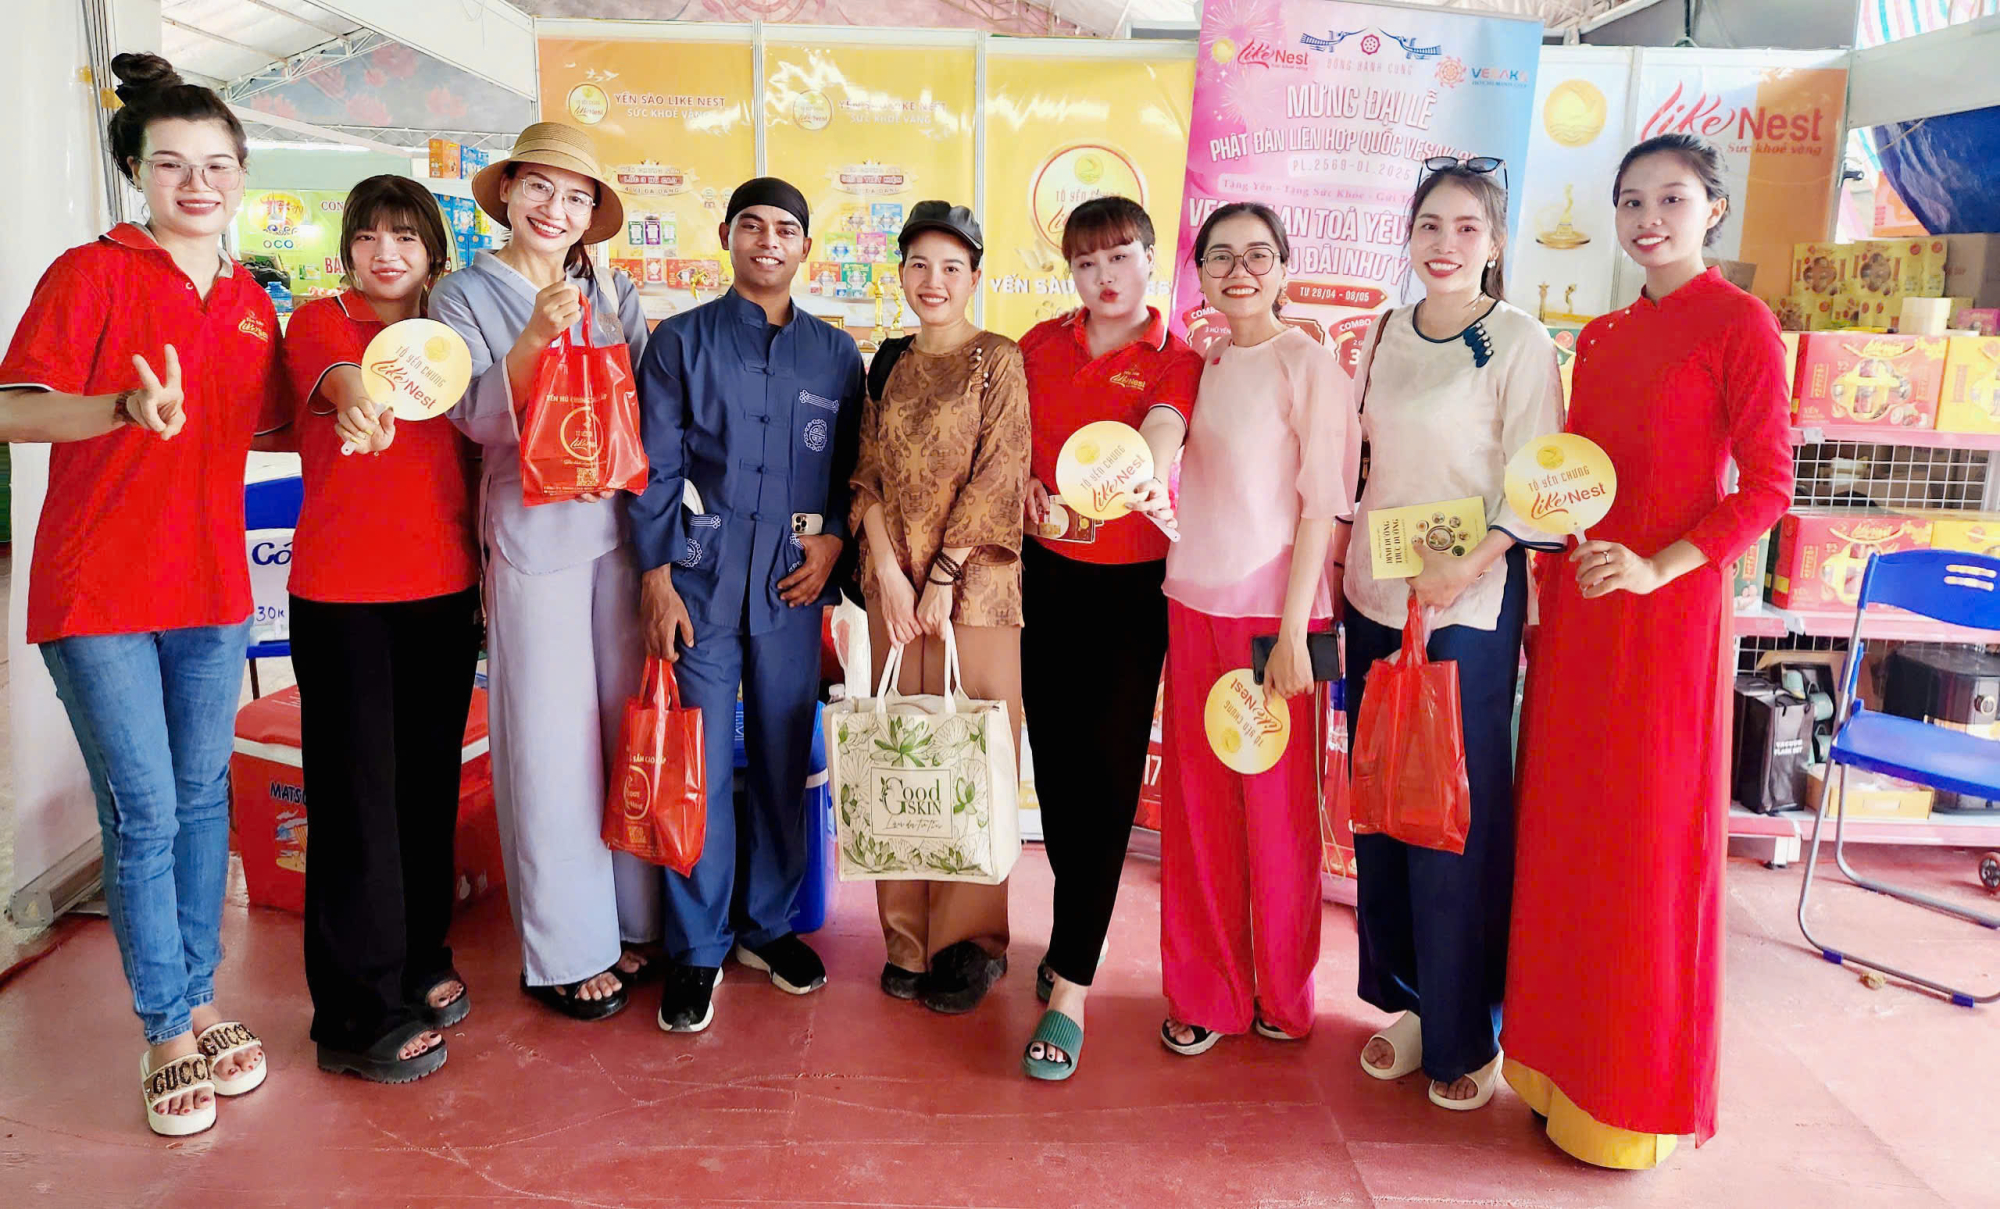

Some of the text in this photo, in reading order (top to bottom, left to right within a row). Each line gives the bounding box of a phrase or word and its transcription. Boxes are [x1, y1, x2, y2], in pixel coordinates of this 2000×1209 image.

[1275, 50, 1308, 65] Nest
[668, 96, 693, 106] LIKE
[697, 97, 725, 107] NEST
[1405, 88, 1439, 130] LỄ
[1737, 106, 1824, 142] Nest
[1210, 132, 1248, 162] PHẬT
[321, 199, 345, 211] CÔN
[263, 240, 295, 248] OCO
[990, 273, 1029, 294] YẾN
[1312, 287, 1336, 299] 28/04
[1345, 292, 1370, 302] 08/05
[1191, 306, 1220, 319] COMB
[1339, 318, 1371, 331] COMBO
[404, 381, 436, 410] Nest
[1116, 454, 1146, 484] Nest
[1567, 482, 1606, 504] Nest
[252, 541, 293, 565] Có
[1230, 678, 1257, 710] Nest
[880, 776, 940, 815] Good
[908, 801, 941, 815] SKIN
[153, 1058, 212, 1094] GUCCI
